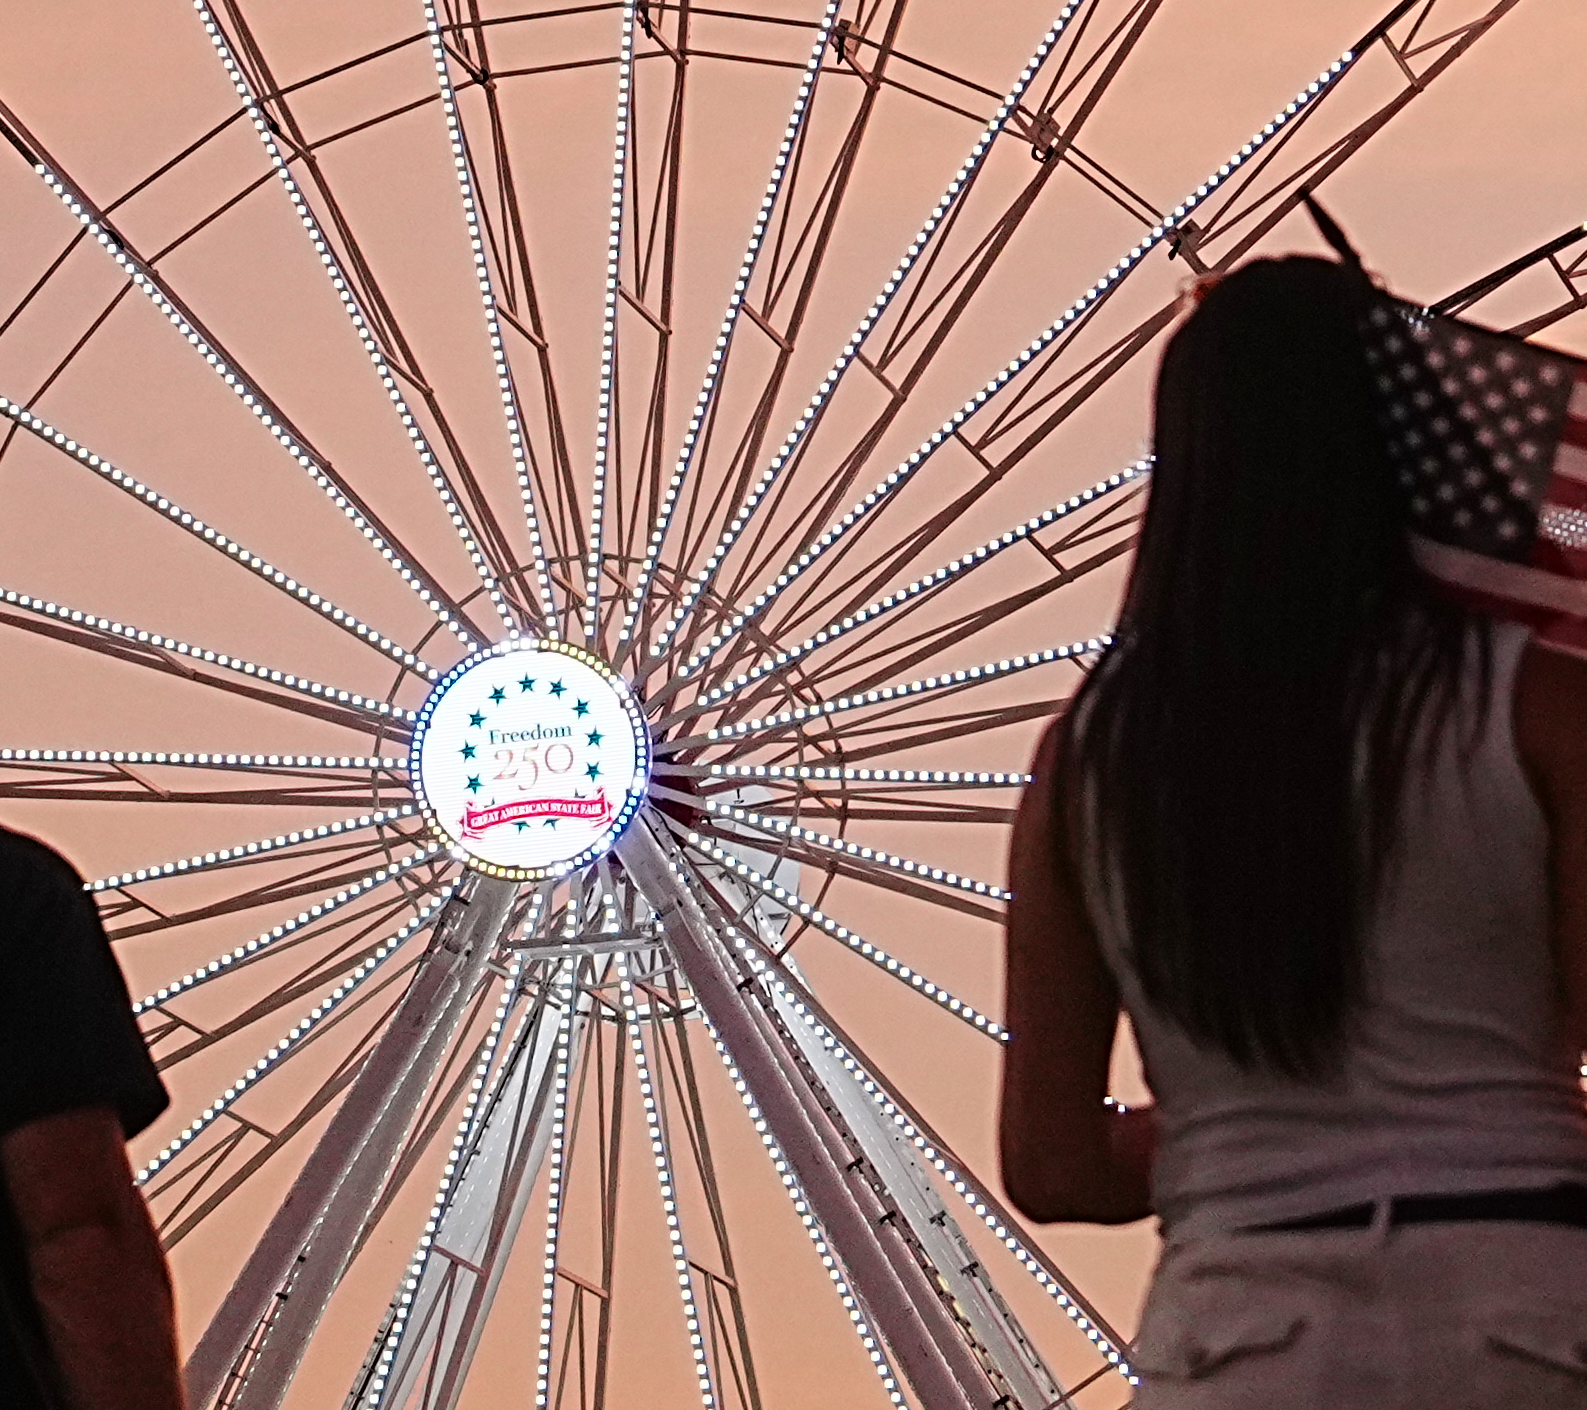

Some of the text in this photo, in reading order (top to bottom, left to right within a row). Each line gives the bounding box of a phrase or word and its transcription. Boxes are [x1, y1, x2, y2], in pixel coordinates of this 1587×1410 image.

[488, 723, 573, 745] Freedom
[493, 742, 574, 791] 250
[470, 802, 603, 828] GREAT AMERICAN STATE FAIR
